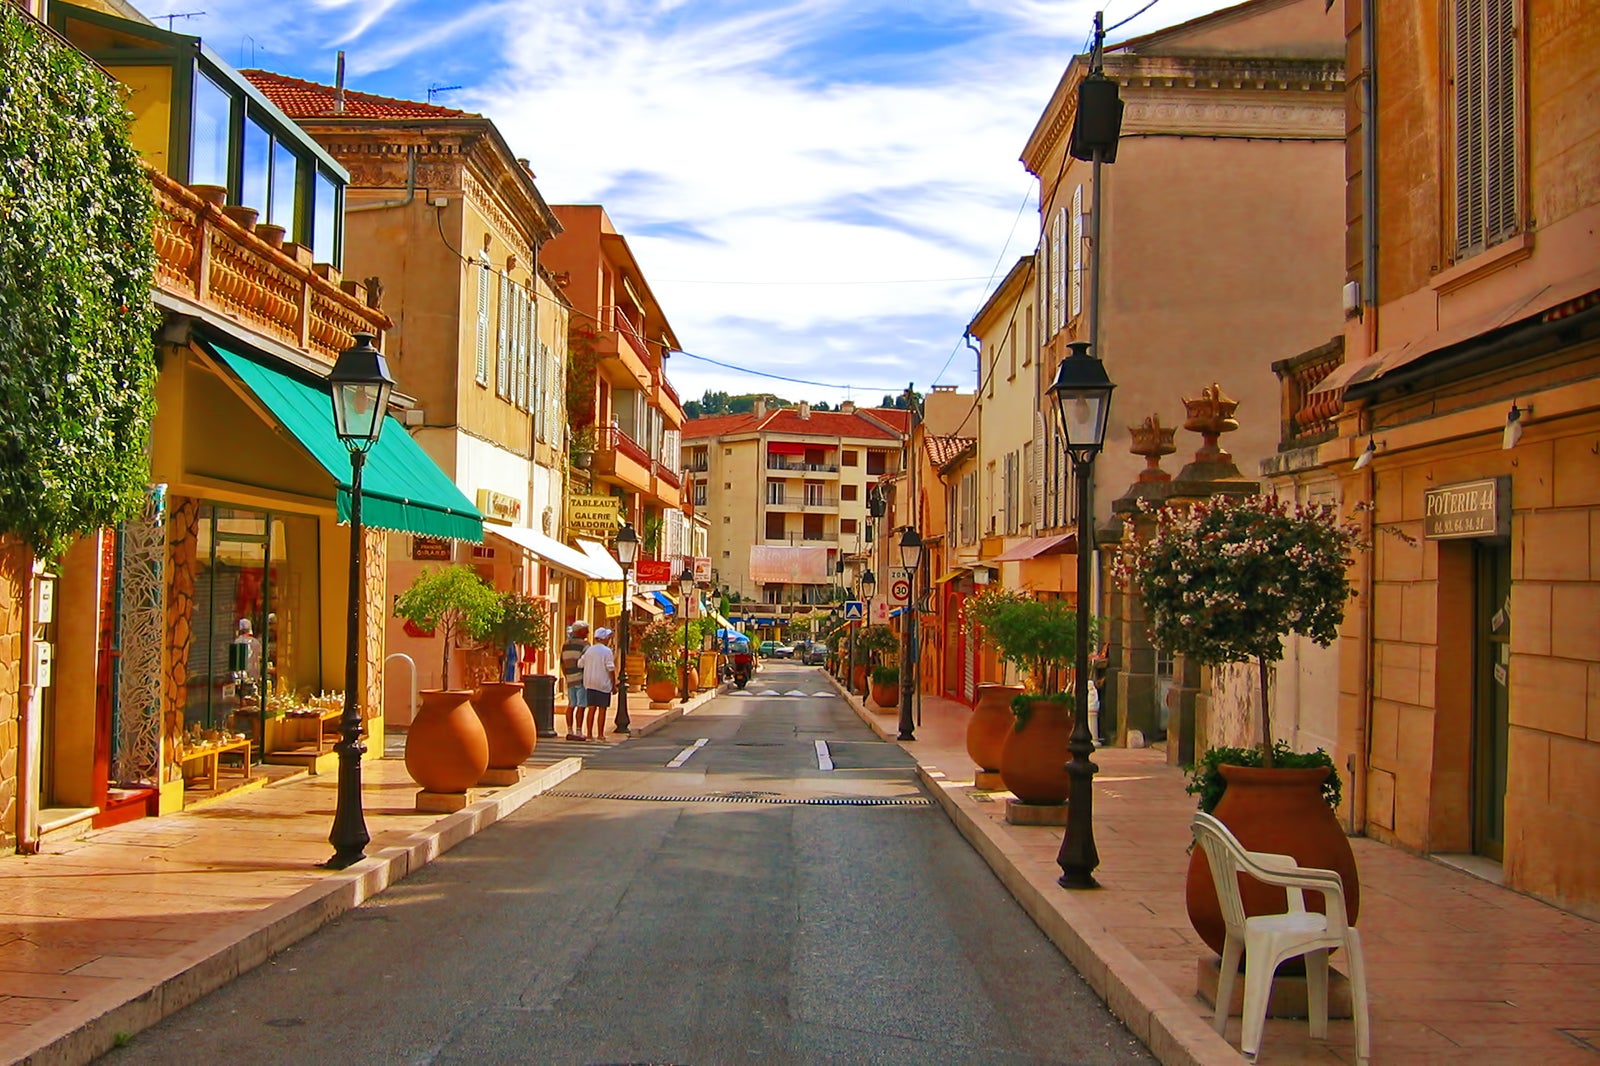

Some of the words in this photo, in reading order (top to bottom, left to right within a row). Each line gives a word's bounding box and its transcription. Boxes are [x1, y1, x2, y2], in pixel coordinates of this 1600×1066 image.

[571, 499, 617, 508] TABLEAUX
[1427, 492, 1478, 516] POTERIE
[1480, 490, 1493, 510] 44
[574, 512, 610, 520] GALERIE
[571, 521, 615, 529] VALDORIA
[896, 586, 907, 595] 30
